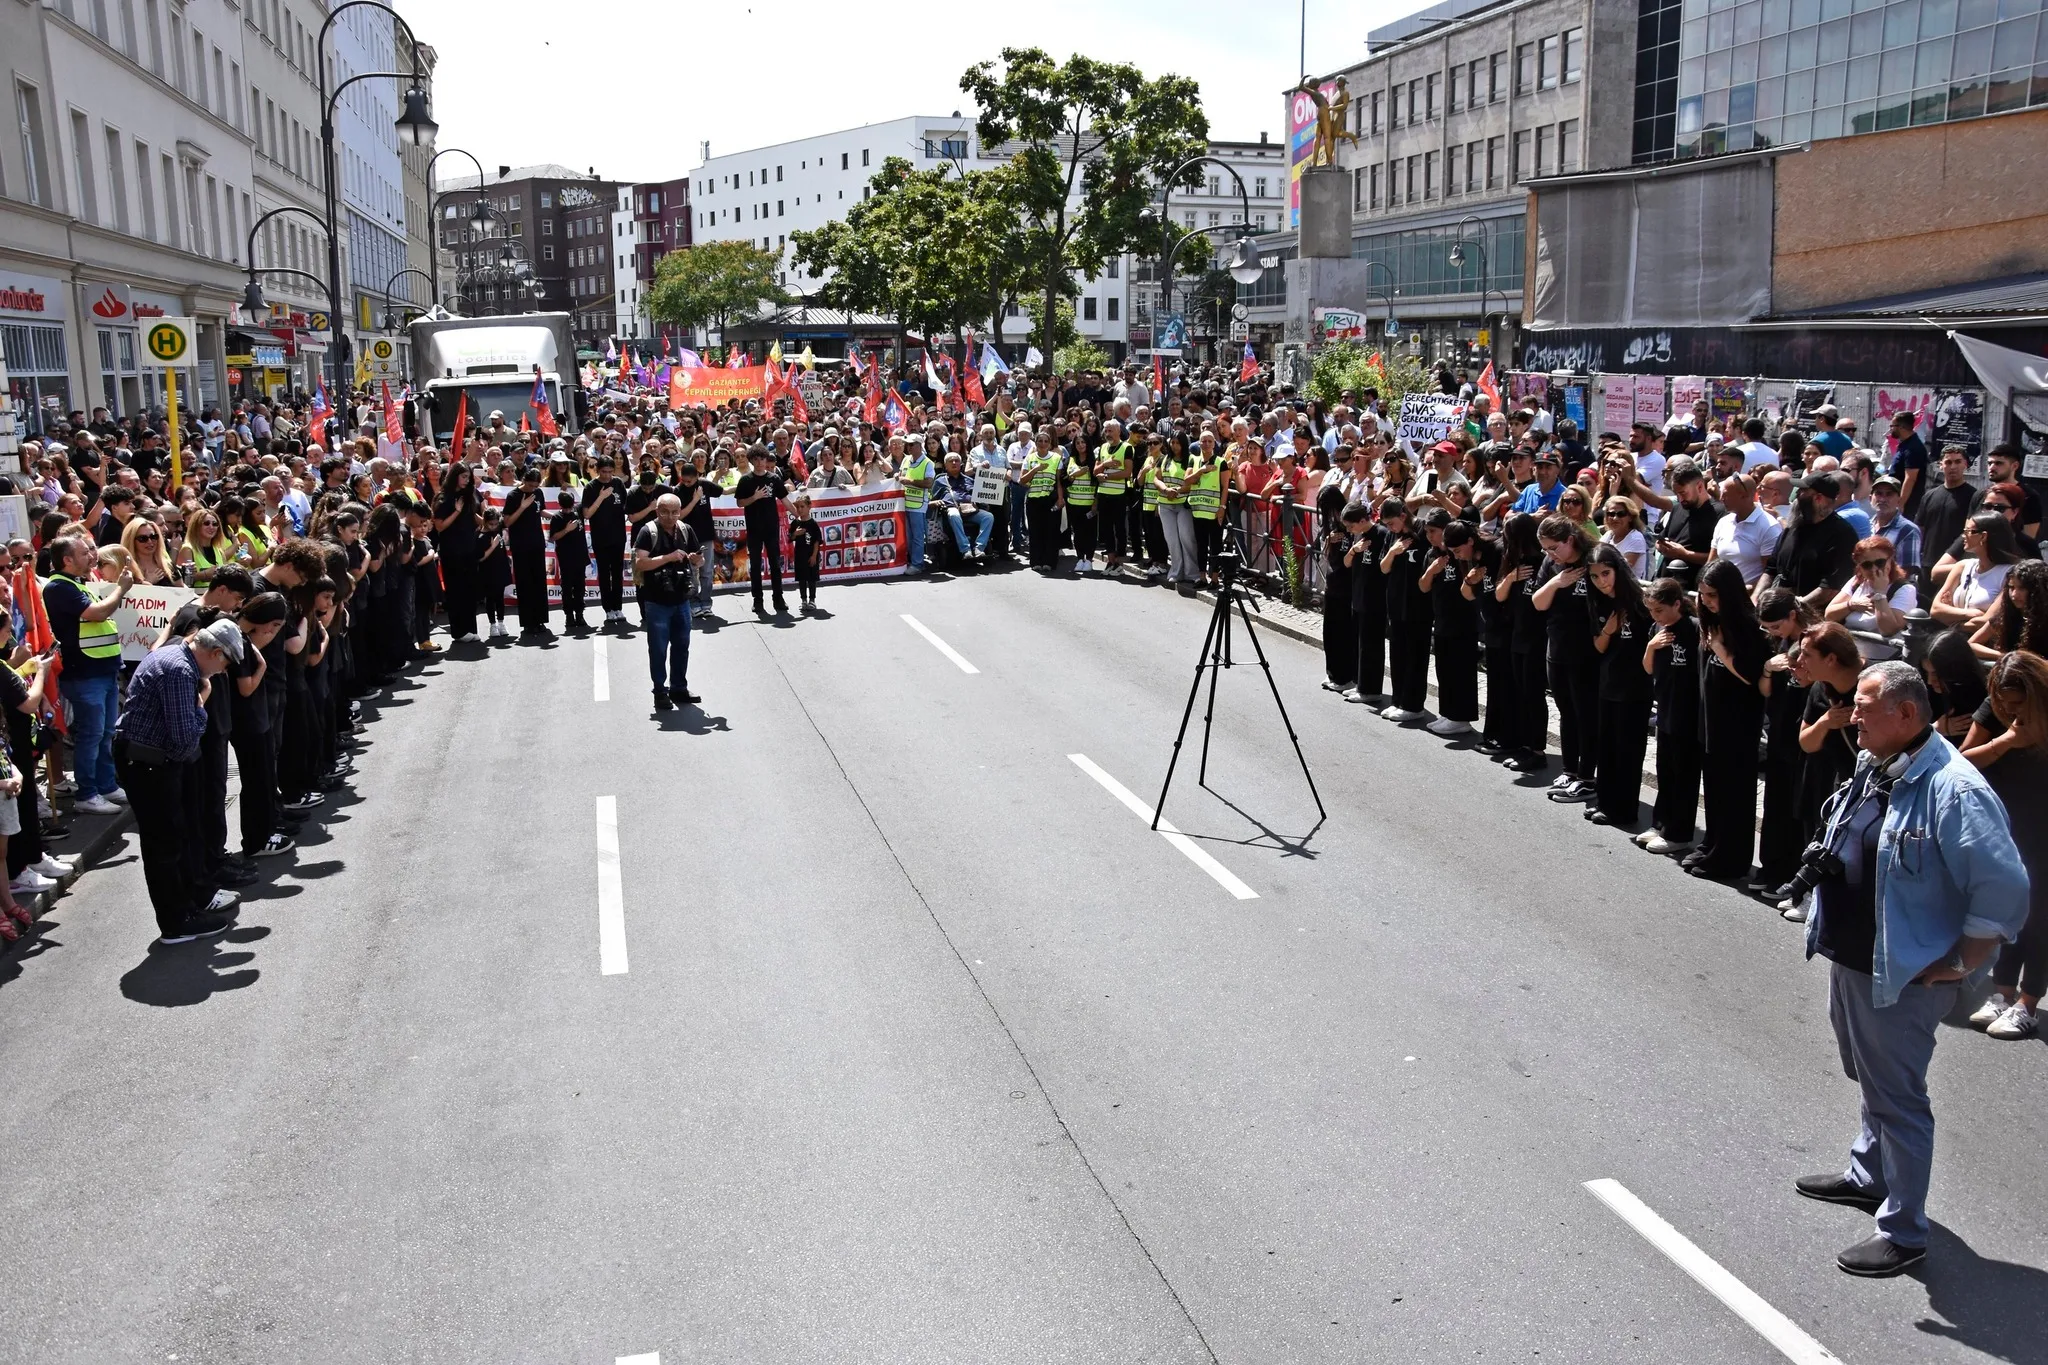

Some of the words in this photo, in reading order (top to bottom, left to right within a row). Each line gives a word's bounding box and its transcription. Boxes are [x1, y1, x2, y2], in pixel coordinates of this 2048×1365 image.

[157, 332, 177, 352] H
[378, 345, 388, 355] H
[458, 355, 527, 364] LOGISTICS
[1405, 393, 1467, 407] GERECHTIGKEIT
[1565, 397, 1581, 405] CLUB
[1403, 402, 1436, 416] SIVAS
[982, 480, 997, 490] hesap
[977, 491, 996, 500] verecek
[820, 509, 848, 519] IMMER
[851, 505, 875, 515] NOCH
[727, 519, 745, 527] FÜR
[716, 530, 740, 538] 1993
